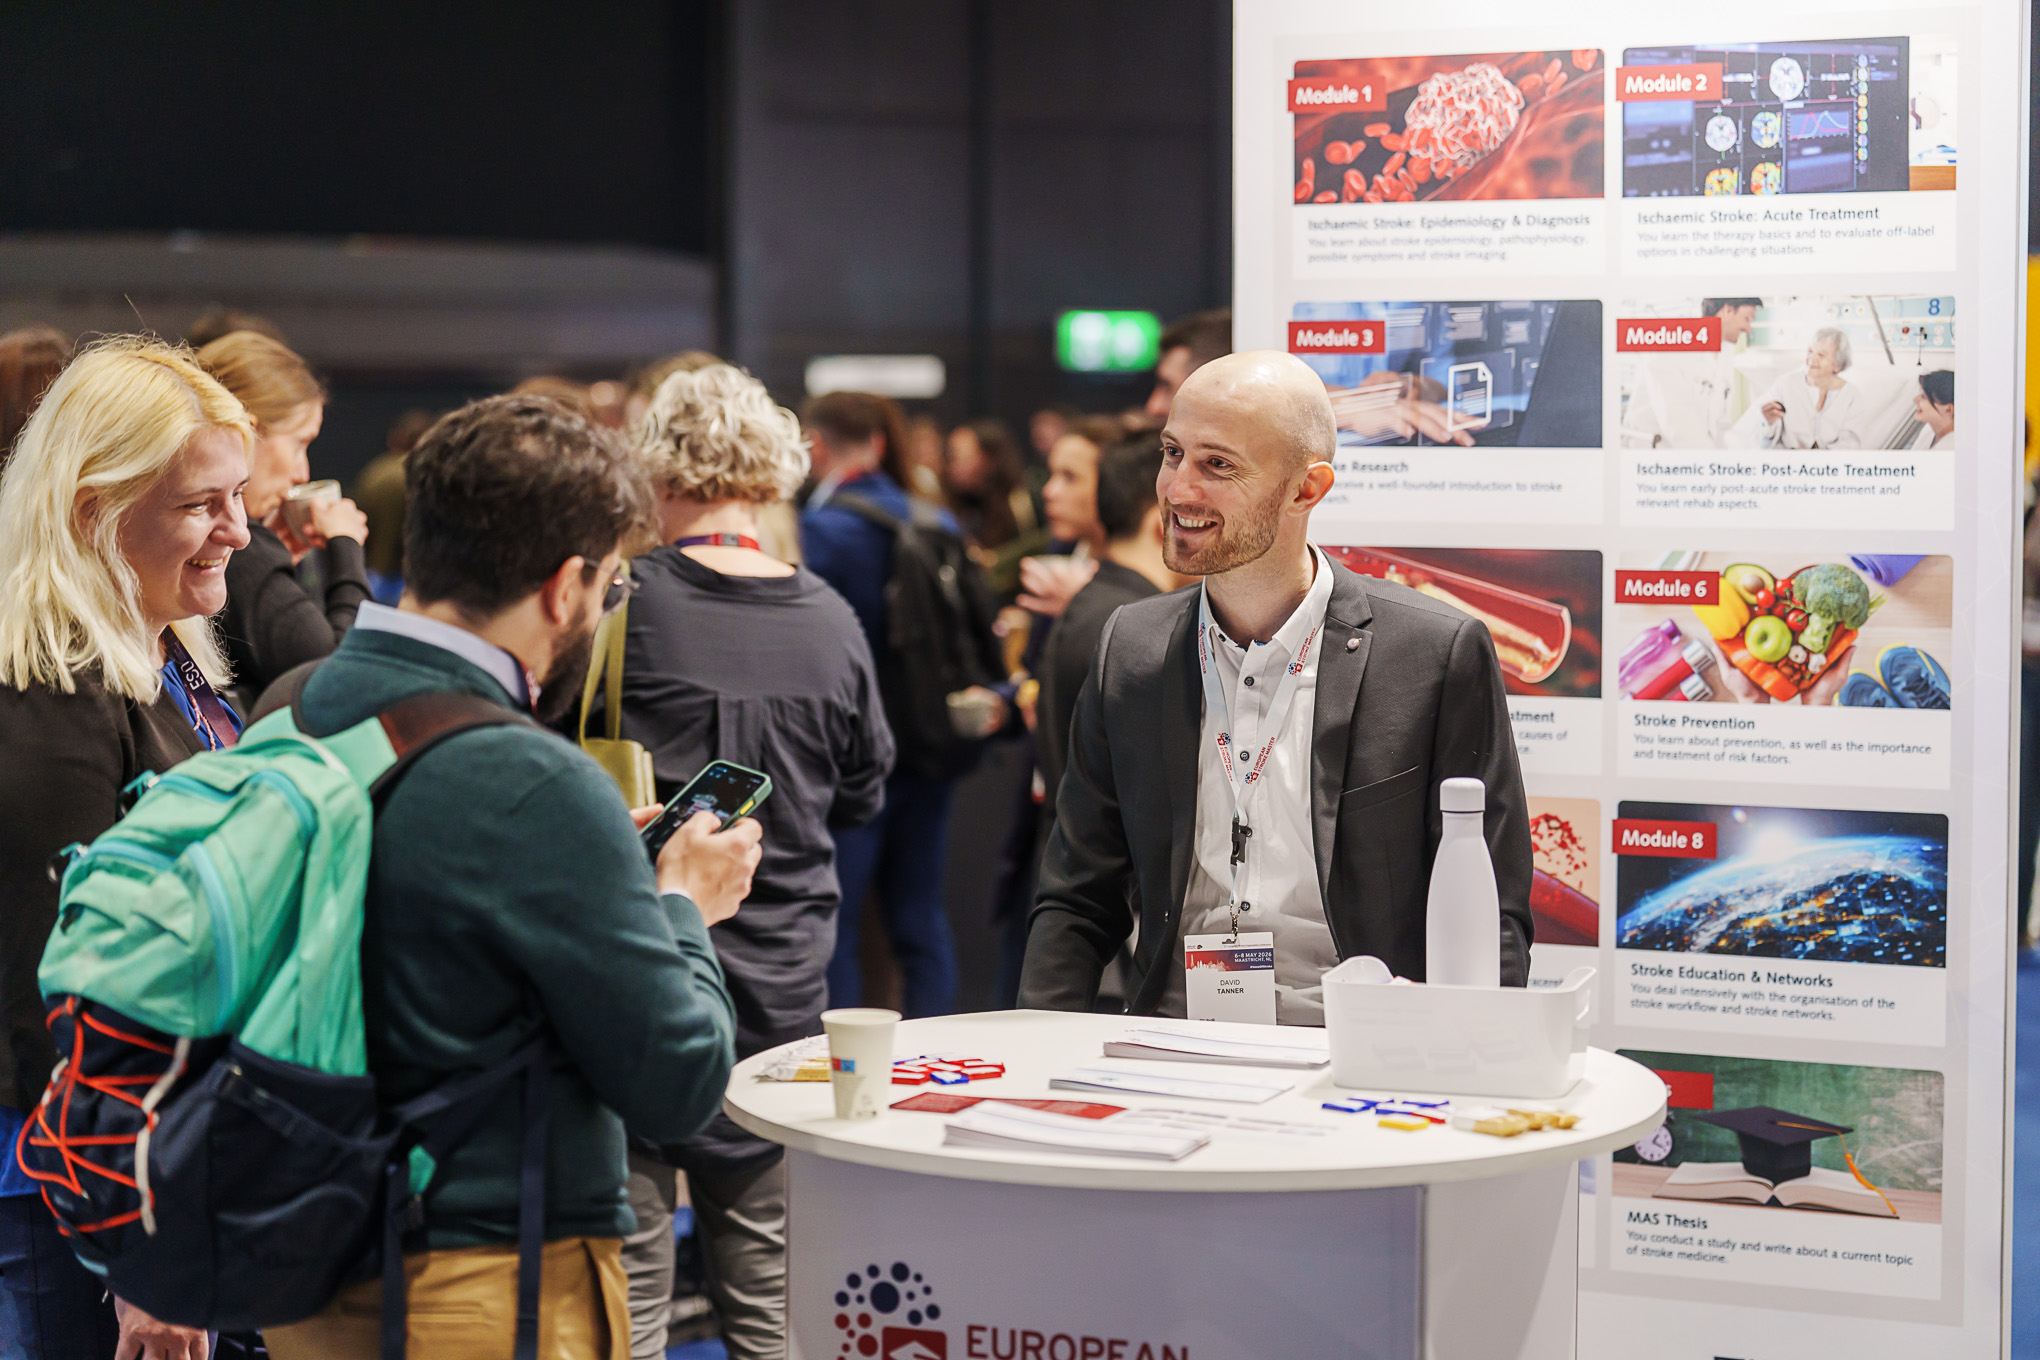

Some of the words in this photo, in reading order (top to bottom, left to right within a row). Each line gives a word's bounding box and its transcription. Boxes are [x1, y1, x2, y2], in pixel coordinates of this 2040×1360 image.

[1625, 73, 1692, 93] Module
[1695, 73, 1707, 91] 2
[1295, 84, 1359, 105] Module
[1361, 84, 1372, 103] 1
[1638, 212, 1704, 224] Ischaemic
[1710, 209, 1757, 223] Stroke:
[1763, 209, 1803, 221] Acute
[1809, 207, 1879, 220] Treatment
[1638, 233, 1658, 242] You
[1661, 231, 1688, 241] learn
[1692, 231, 1709, 241] the
[1713, 230, 1755, 243] therapy
[1759, 229, 1791, 240] basics
[1795, 227, 1816, 240] and
[1820, 228, 1831, 239] to
[1835, 227, 1883, 238] evaluate
[1886, 224, 1934, 237] off-label
[1637, 248, 1677, 260] options
[1681, 247, 1691, 256] in
[1694, 245, 1757, 259] challenging
[1928, 298, 1940, 316] 8
[1296, 328, 1359, 347] Module
[1361, 328, 1374, 347] 3
[1626, 325, 1693, 345] Module
[1695, 326, 1709, 344] 4
[1351, 460, 1409, 473] Research
[1637, 463, 1703, 475] Ischaemic
[1709, 463, 1755, 475] Stroke:
[1762, 463, 1838, 477] Post-Acute
[1845, 464, 1915, 477] Treatment
[1333, 481, 1364, 490] eceive
[1637, 483, 1657, 493] You
[1660, 482, 1687, 493] learn
[1691, 483, 1717, 496] early
[1721, 484, 1779, 497] post-acute
[1783, 483, 1816, 494] stroke
[1820, 484, 1875, 495] treatment
[1879, 484, 1900, 495] and
[1636, 498, 1679, 508] relevant
[1683, 498, 1714, 509] rehab
[1718, 499, 1760, 511] aspects.
[1624, 578, 1691, 597] Module
[1694, 580, 1708, 598] 6
[180, 660, 205, 691] ESO
[1510, 710, 1555, 724] atment
[1634, 713, 1676, 727] Stroke
[1682, 715, 1755, 730] Prevention
[1634, 734, 1654, 745] You
[1658, 735, 1684, 745] learn
[1688, 736, 1719, 747] about
[1723, 738, 1785, 751] prevention,
[1789, 741, 1801, 750] as
[1804, 740, 1827, 751] well
[1831, 742, 1842, 751] as
[1846, 741, 1864, 752] the
[1868, 742, 1931, 755] importance
[1253, 746, 1267, 772] EUROPEAN
[1257, 755, 1269, 773] STROKE
[1265, 736, 1276, 755] MASTER
[1633, 748, 1654, 759] and
[1657, 750, 1710, 761] treatment
[1713, 750, 1726, 761] of
[1729, 752, 1747, 763] risk
[1751, 752, 1791, 765] factors.
[1621, 828, 1689, 849] Module
[1691, 831, 1704, 850] 8
[1631, 963, 1674, 978] Stroke
[1679, 966, 1745, 981] Education
[1751, 971, 1761, 983] &
[1767, 972, 1833, 988] Networks
[1217, 987, 1245, 995] TANNER
[1631, 983, 1651, 994] You
[1654, 984, 1677, 996] deal
[1680, 987, 1737, 1001] intensively
[1741, 991, 1765, 1001] with
[1769, 991, 1786, 1003] the
[1790, 994, 1858, 1007] organisation
[1862, 997, 1874, 1008] of
[1877, 997, 1895, 1010] the
[1630, 999, 1663, 1009] stroke
[1666, 1001, 1717, 1013] workflow
[1721, 1004, 1741, 1015] and
[1745, 1006, 1778, 1017] stroke
[1782, 1009, 1836, 1021] networks.
[1628, 1211, 1660, 1225] MAS
[1665, 1212, 1708, 1230] Thesis
[1626, 1245, 1638, 1257] of
[1641, 1247, 1674, 1259] stroke
[1677, 1251, 1728, 1263] medicine.
[1627, 1230, 1647, 1242] You
[1650, 1234, 1693, 1246] conduct
[1698, 1238, 1704, 1247] a
[1707, 1238, 1737, 1251] study
[1740, 1242, 1761, 1252] and
[1764, 1244, 1792, 1255] write
[1796, 1246, 1828, 1258] about
[1832, 1250, 1838, 1259] a
[1841, 1251, 1881, 1263] current
[1885, 1253, 1913, 1267] topic
